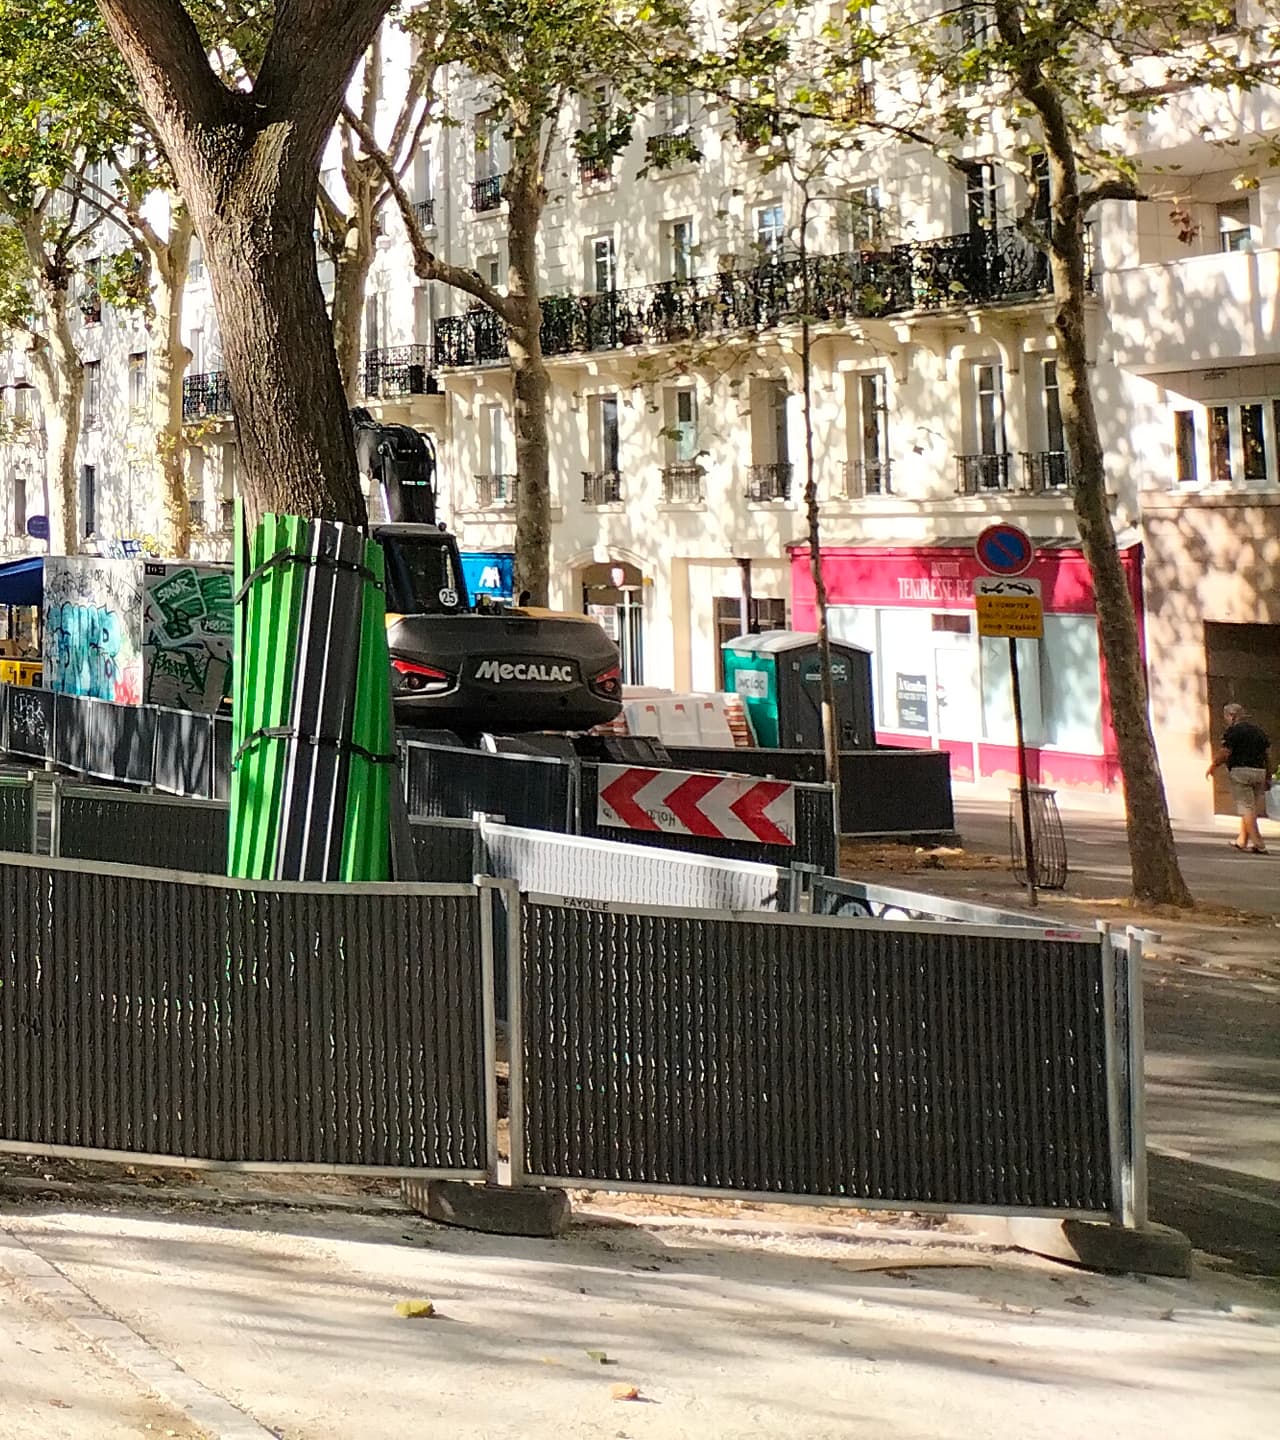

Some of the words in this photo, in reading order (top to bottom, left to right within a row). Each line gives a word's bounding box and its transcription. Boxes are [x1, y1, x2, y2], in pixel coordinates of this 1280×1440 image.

[897, 577, 954, 601] TENDRESSE
[441, 591, 456, 604] 25
[563, 897, 610, 911] FAYOLLE
